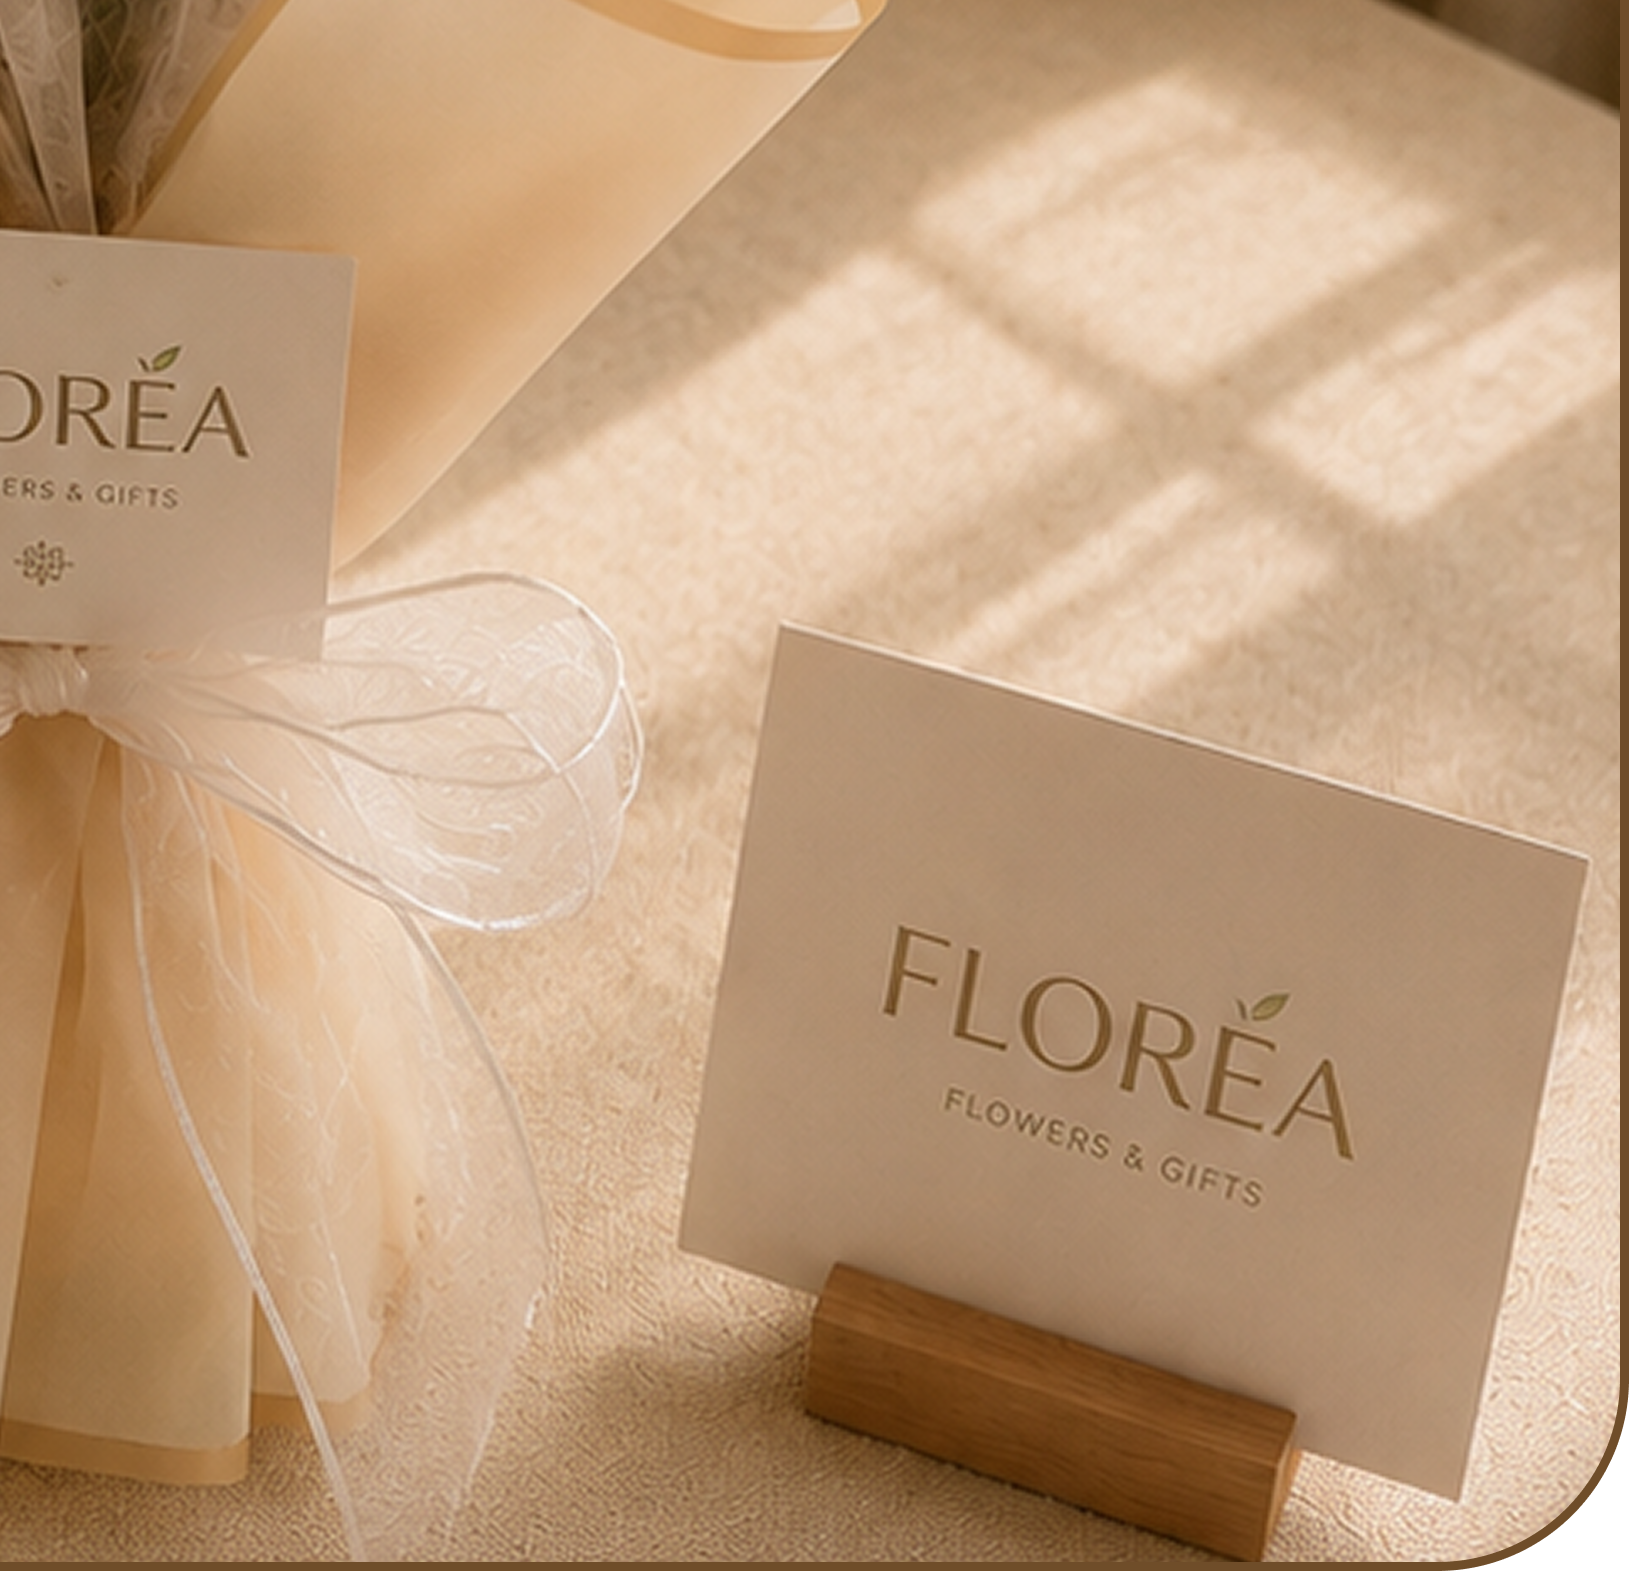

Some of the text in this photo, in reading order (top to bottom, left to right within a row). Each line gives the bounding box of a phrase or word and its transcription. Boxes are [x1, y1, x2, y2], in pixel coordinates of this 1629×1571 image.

[65, 483, 83, 503] &
[95, 483, 180, 510] GIFTS
[943, 1086, 1265, 1209] FLOWERS & GIFTS
